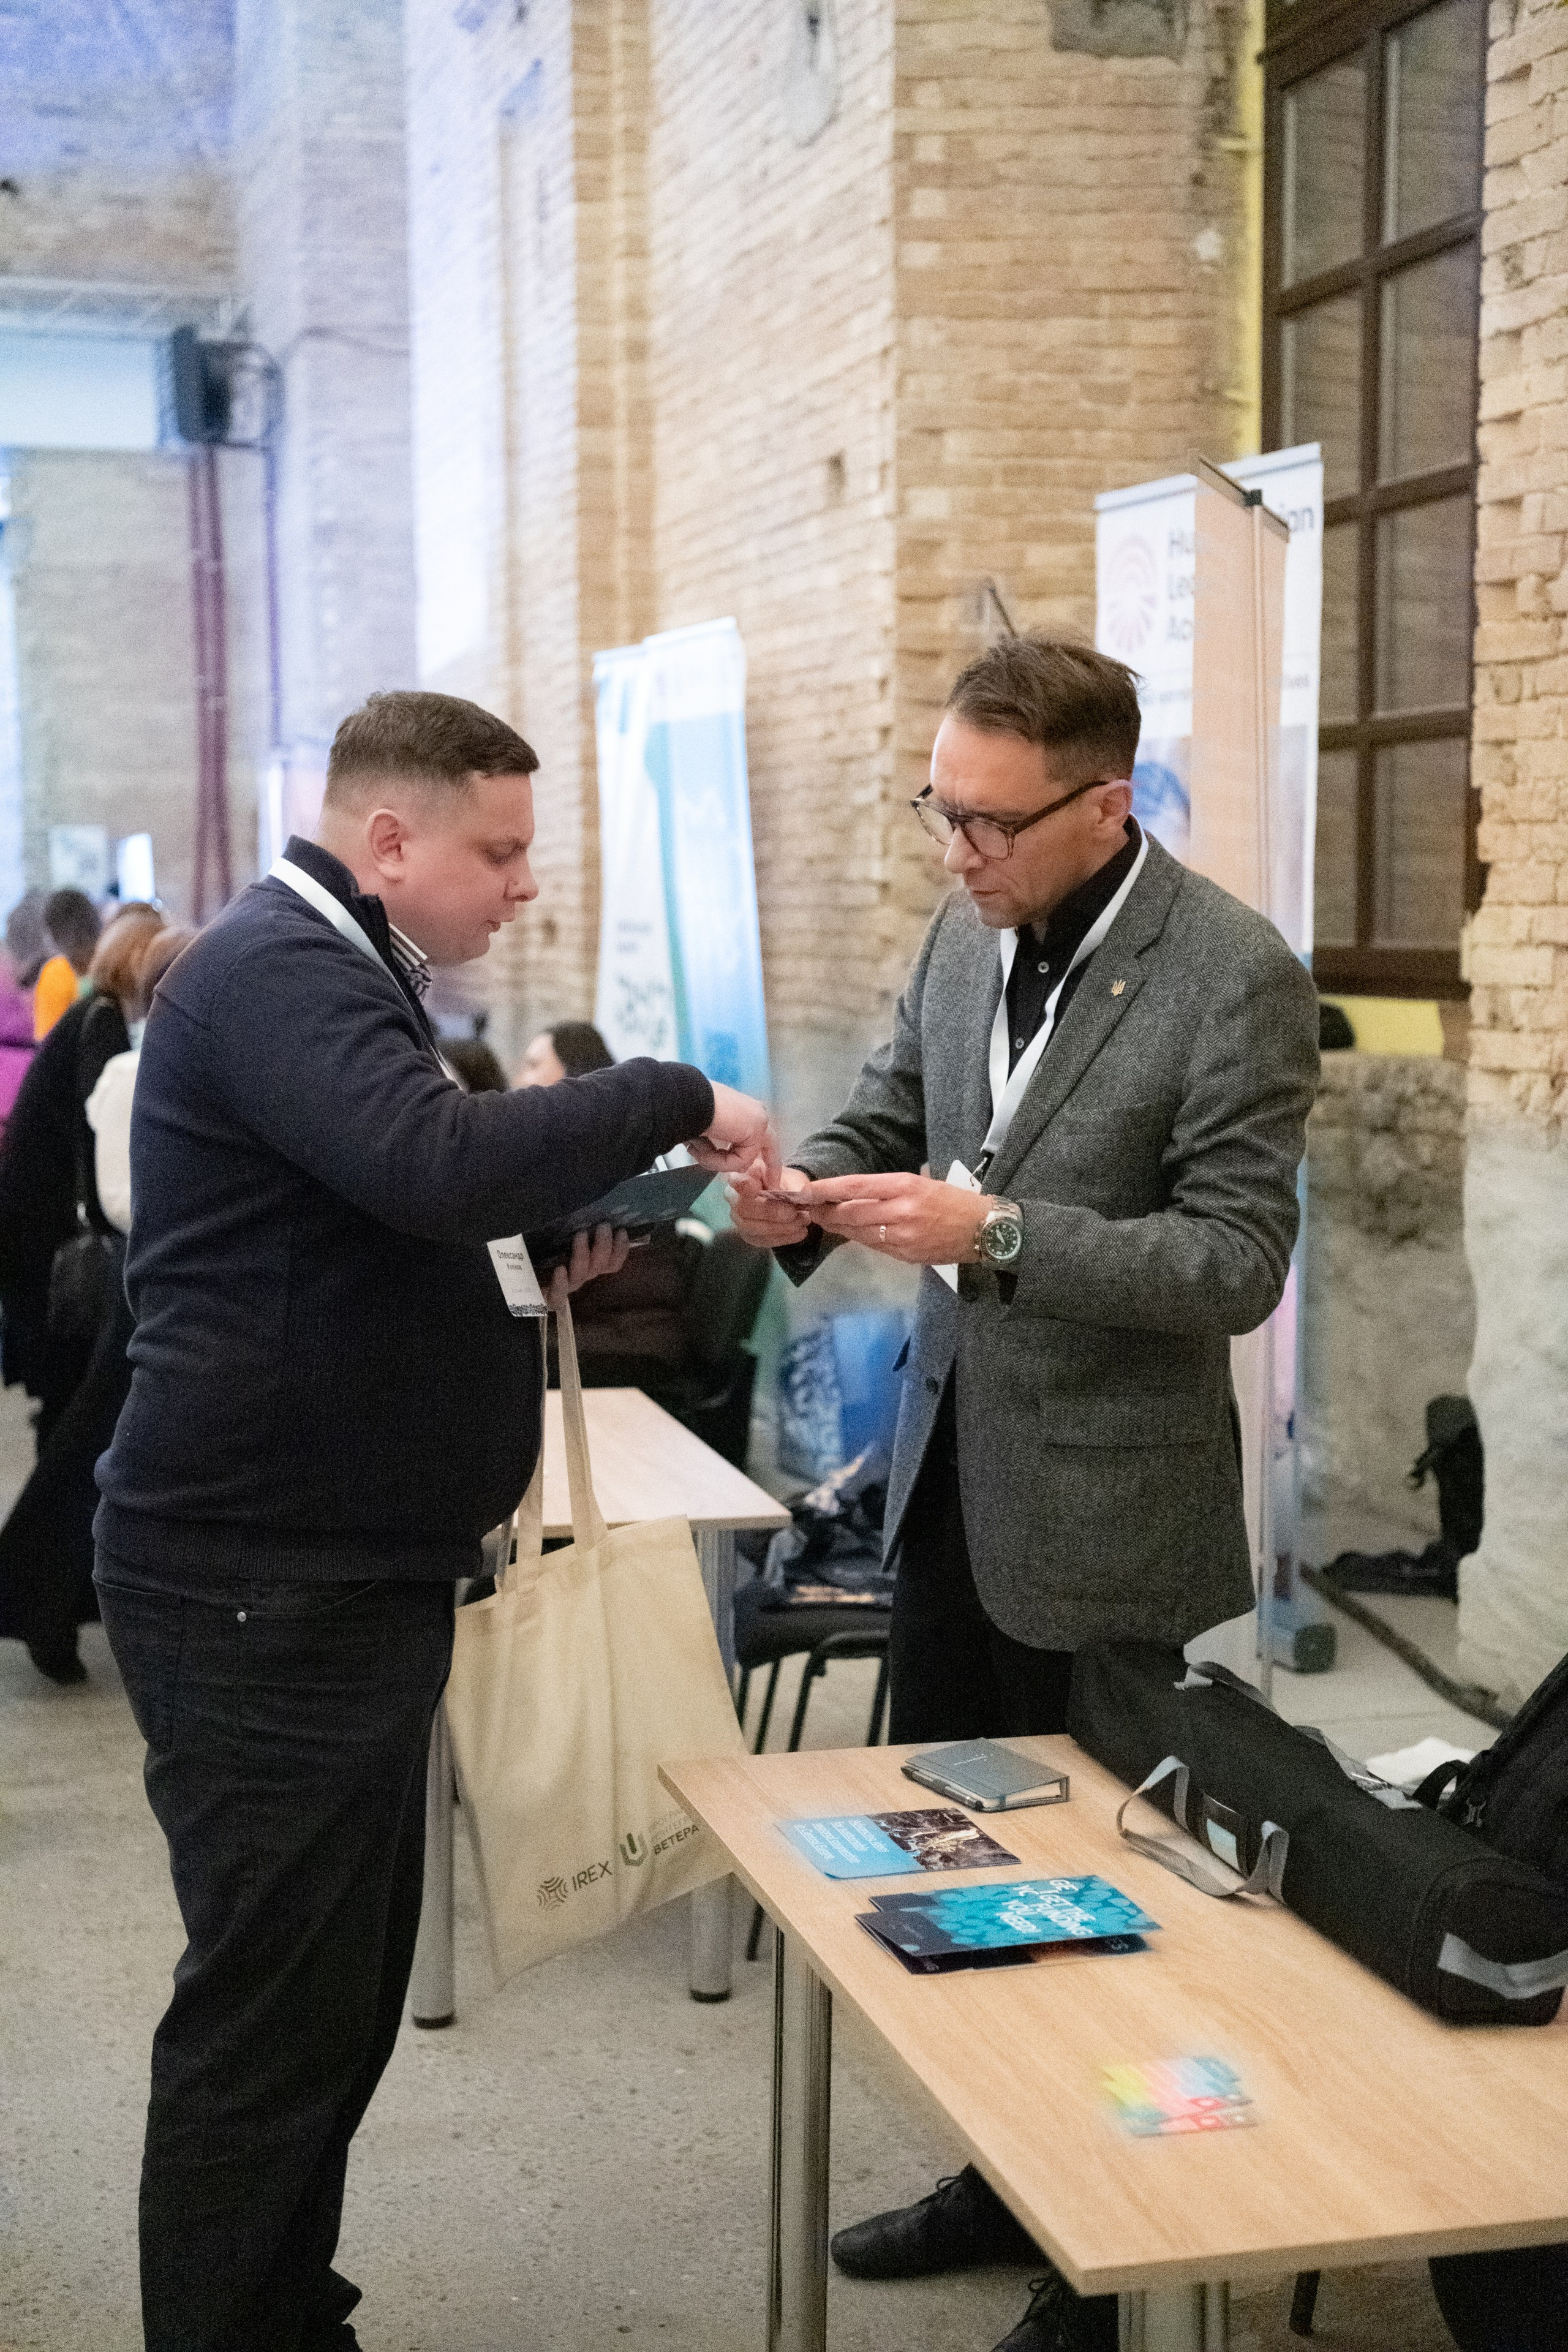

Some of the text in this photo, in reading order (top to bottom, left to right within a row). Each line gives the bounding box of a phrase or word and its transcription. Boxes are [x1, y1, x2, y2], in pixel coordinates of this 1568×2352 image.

[571, 1860, 612, 1891] IREX
[1001, 1899, 1039, 1915] YOU
[1029, 1902, 1094, 1936] FUNDING
[1039, 1894, 1096, 1921] GET THE
